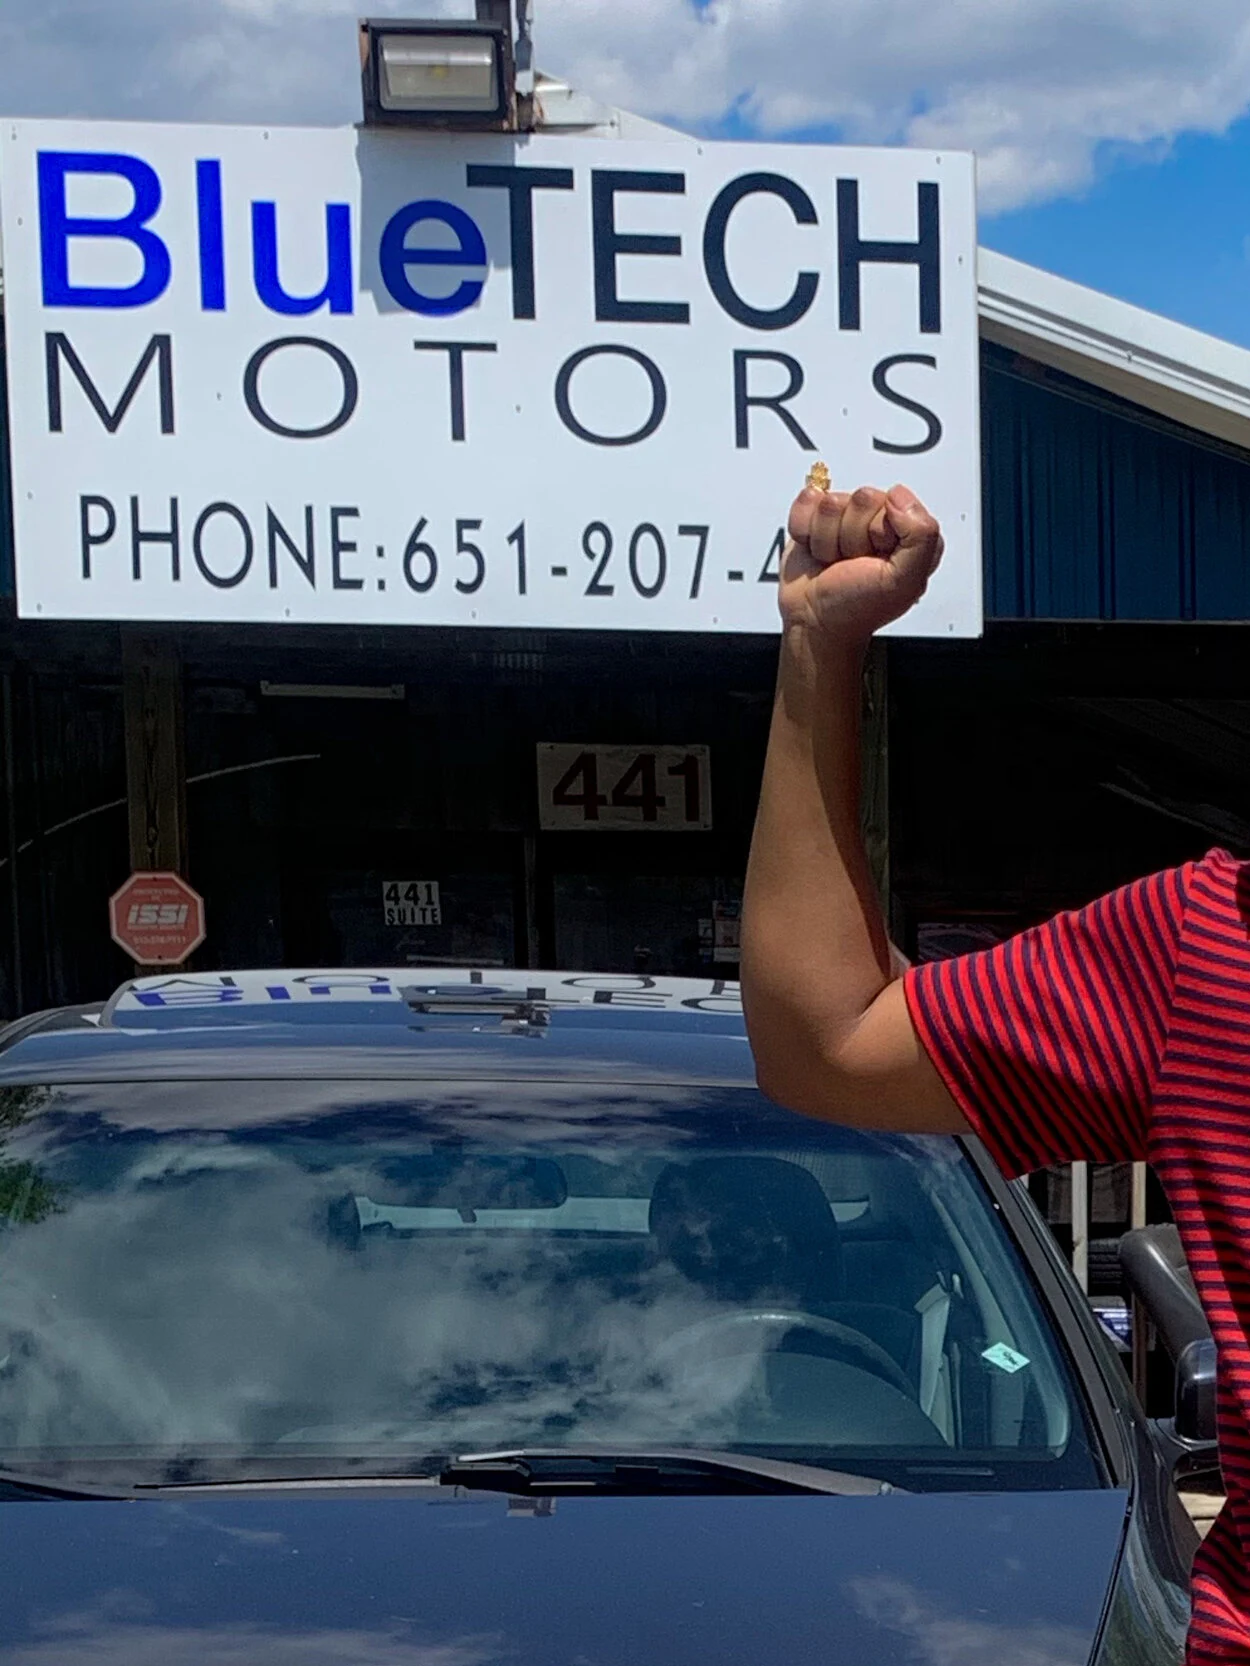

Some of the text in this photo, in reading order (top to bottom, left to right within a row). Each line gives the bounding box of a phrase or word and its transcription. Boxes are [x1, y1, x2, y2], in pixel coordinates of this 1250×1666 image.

[37, 150, 942, 334] BlueTECH
[45, 331, 944, 455] MOTORS
[552, 752, 700, 822] 441
[385, 883, 435, 906] 441
[387, 907, 439, 925] SUITE
